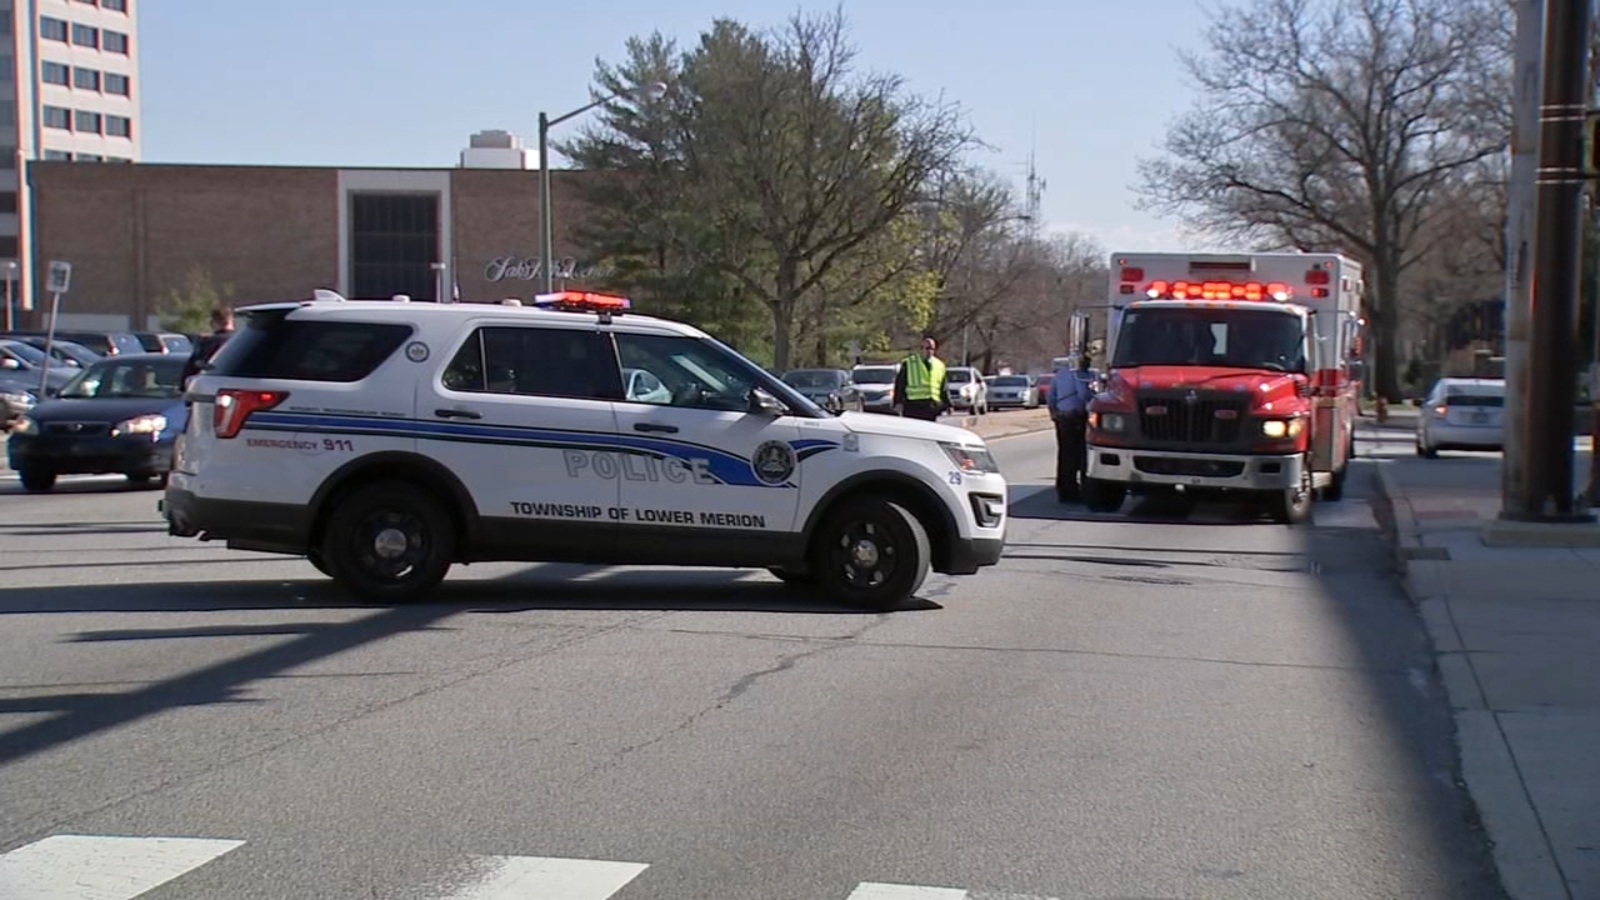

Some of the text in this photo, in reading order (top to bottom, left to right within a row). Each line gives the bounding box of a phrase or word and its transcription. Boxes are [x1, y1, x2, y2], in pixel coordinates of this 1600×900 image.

[246, 438, 354, 452] EMERGENCY 911
[562, 450, 716, 485] POLICE
[948, 471, 962, 486] 29
[510, 501, 766, 528] TOWNSHIP OF LOWER MERION
